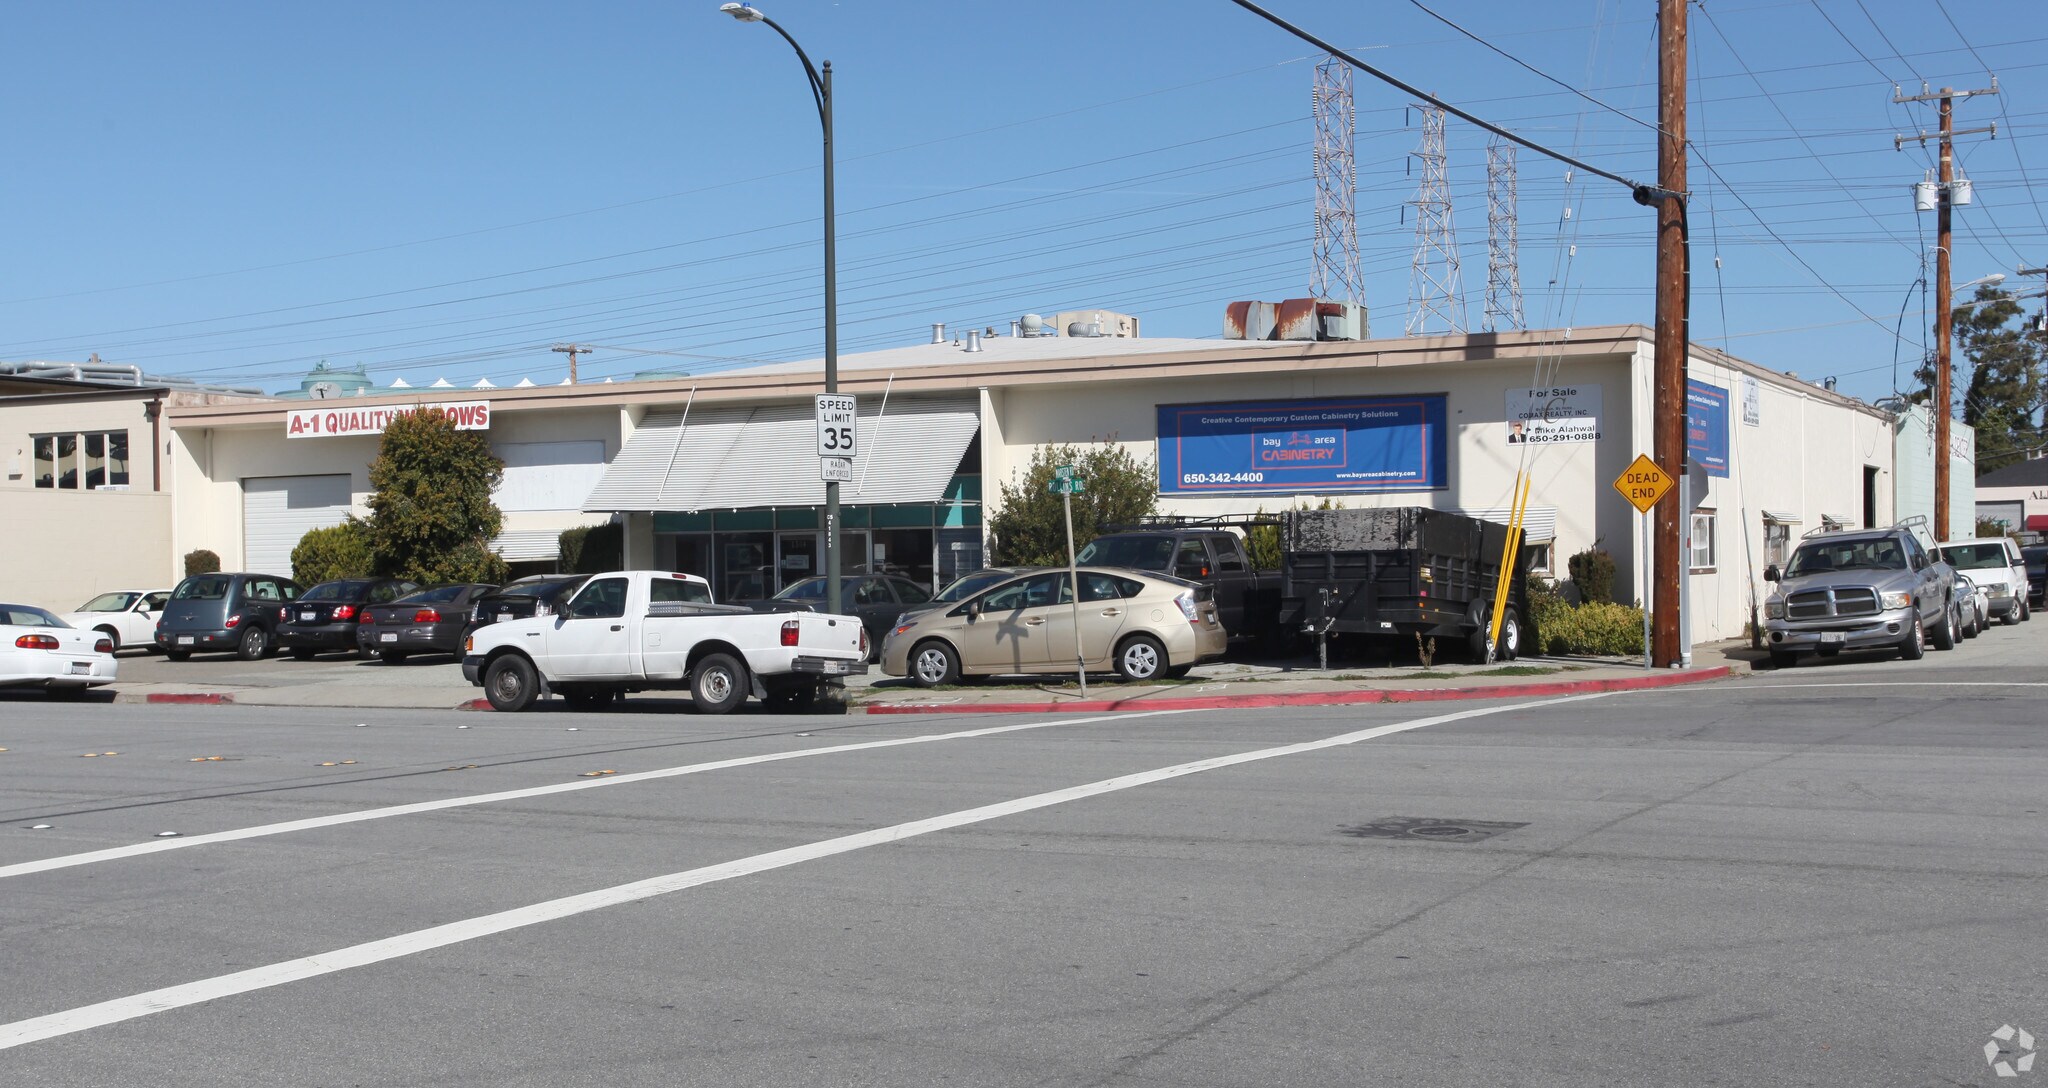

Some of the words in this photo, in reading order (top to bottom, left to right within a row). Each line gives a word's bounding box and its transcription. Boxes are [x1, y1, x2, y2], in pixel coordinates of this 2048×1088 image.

[1529, 390, 1548, 398] For
[1552, 388, 1577, 396] Sale
[819, 400, 854, 411] SPEED
[289, 414, 320, 434] A-1
[325, 409, 394, 435] QUALITY
[823, 413, 851, 423] LIMIT
[1234, 415, 1288, 424] Contemporary
[1558, 425, 1595, 433] Alahwal
[823, 427, 853, 450] 35
[1263, 438, 1281, 447] bay
[1314, 436, 1336, 444] area
[1529, 432, 1601, 442] 650-291-0888
[1262, 448, 1335, 461] CABINETRY
[826, 470, 849, 478] ENFORCED
[1183, 472, 1264, 484] 650-342-4400
[1336, 470, 1417, 479] www.bayareacabinetry.com
[1627, 472, 1660, 484] DEAD
[1632, 488, 1656, 498] END
